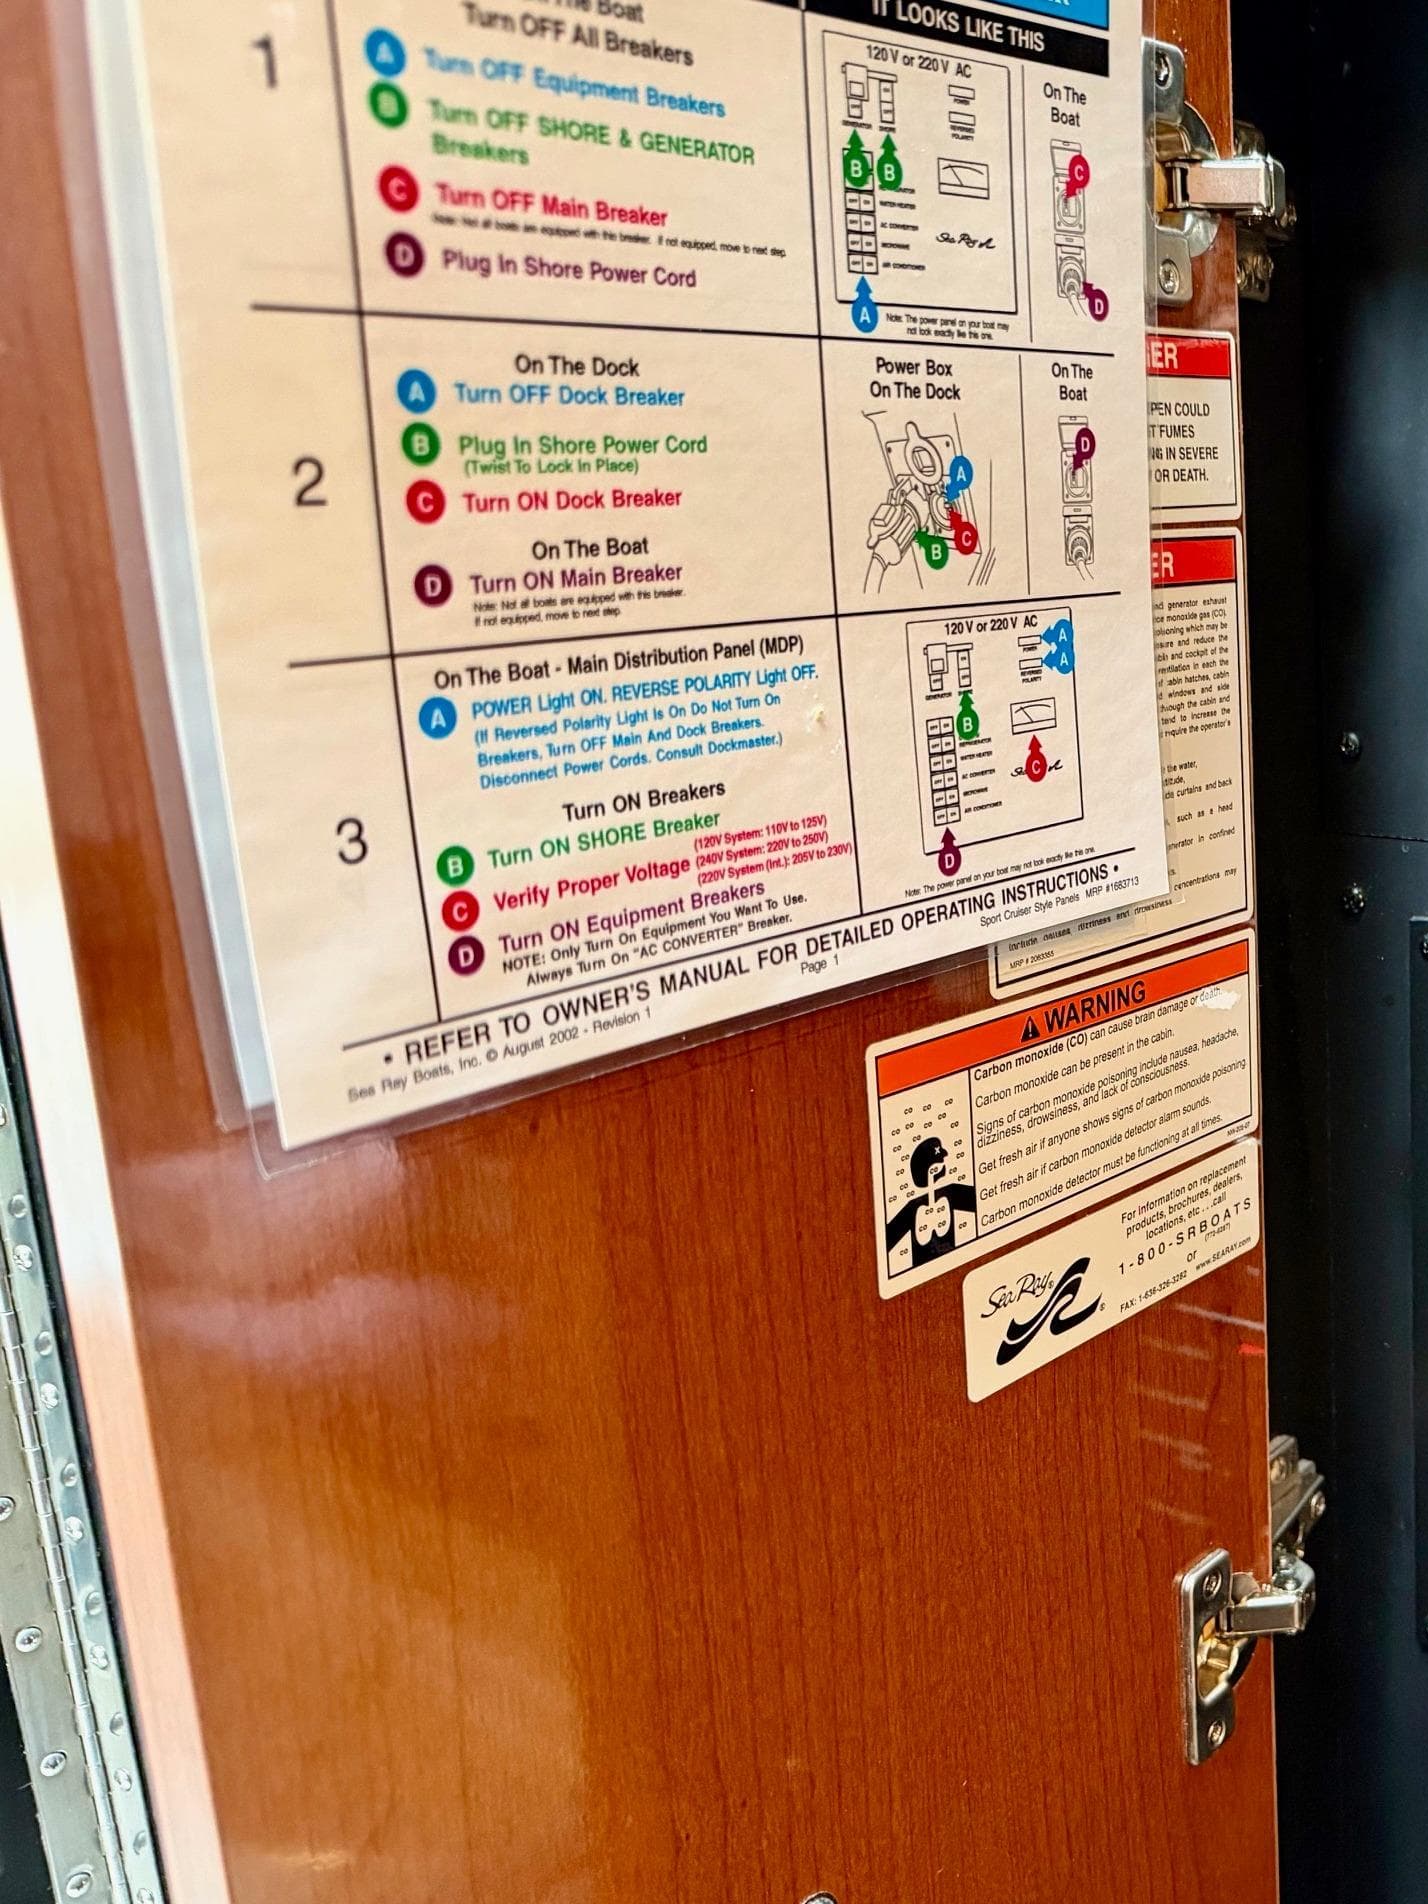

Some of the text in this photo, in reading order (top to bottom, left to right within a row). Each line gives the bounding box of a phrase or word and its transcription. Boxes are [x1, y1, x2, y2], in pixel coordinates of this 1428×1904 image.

[467, 4, 693, 66] Turn OFF All Breakers
[897, 0, 1044, 52] LOOKS LIKE THIS
[515, 354, 639, 377] On The Dock
[876, 356, 953, 376] Power Box
[870, 381, 960, 400] On The Dock
[1172, 402, 1210, 416] COULD
[459, 435, 707, 459] Plug In Shore Power Cord
[1159, 425, 1196, 439] FUMES
[1164, 447, 1218, 460] IN SEVERE
[292, 455, 327, 507] 2
[1155, 468, 1208, 482] OR DEATH.
[470, 564, 682, 593] Turn ON Main Breaker
[562, 783, 725, 821] Turn ON Breakers
[336, 816, 369, 864] 3
[487, 813, 720, 868] Turn ON SHORE Breaker
[494, 859, 690, 910] Verify Proper Voltage
[498, 883, 765, 953] Turn ON Equipment Breakers
[980, 913, 1002, 928] Sport
[1004, 906, 1032, 920] Cruiser
[1034, 900, 1053, 913] Style
[1055, 893, 1080, 906] Panels
[1085, 885, 1103, 898] MRP
[405, 864, 1108, 1063] REFER TO OWNER'S MANUAL FOR DETAILED OPERATING INSTRUCTIONS
[1043, 980, 1146, 1033] WARNING
[974, 1061, 1012, 1081] Carbon
[1015, 1042, 1064, 1067] monoxide
[1066, 1032, 1088, 1051] (CO)
[1090, 1028, 1106, 1041] can
[1108, 1019, 1133, 1035] cause
[1135, 1011, 1155, 1025] brain
[1157, 999, 1188, 1017] damage
[1190, 995, 1198, 1006] or
[975, 1029, 1174, 1108] Carbon monoxide can be present in the cabin.
[1187, 1250, 1197, 1262] or
